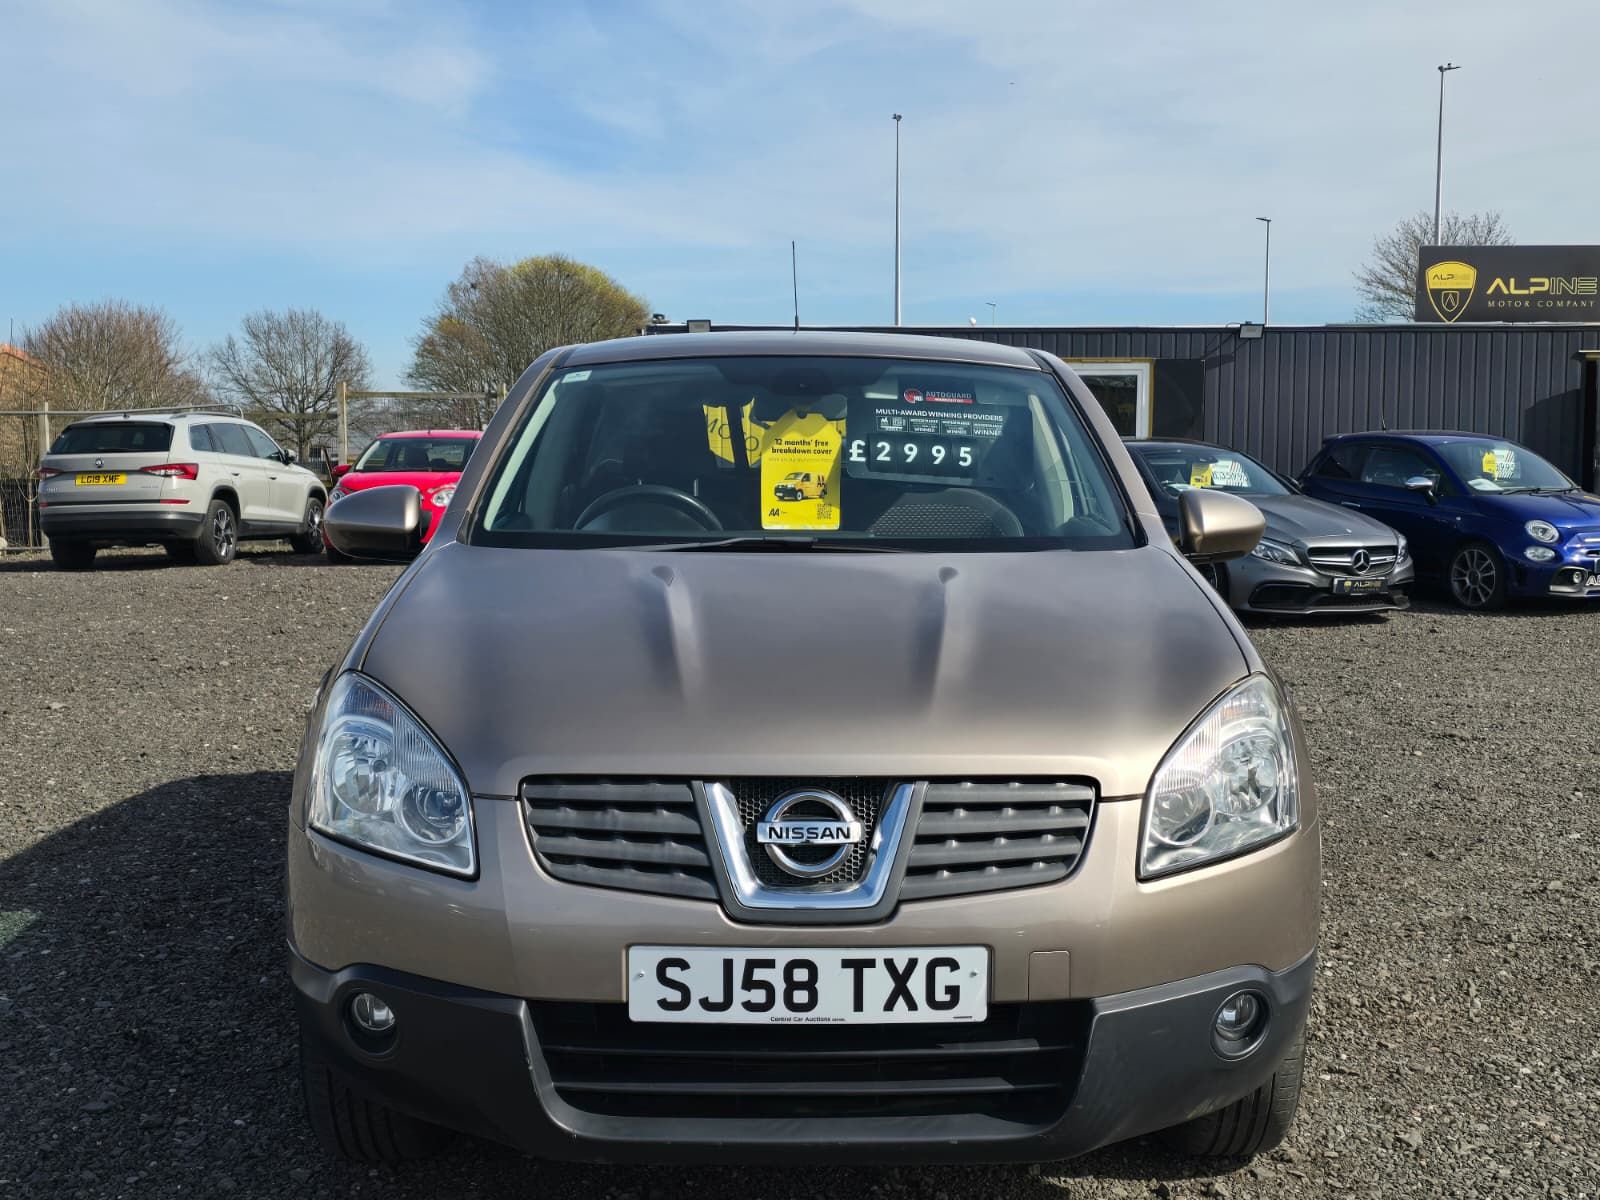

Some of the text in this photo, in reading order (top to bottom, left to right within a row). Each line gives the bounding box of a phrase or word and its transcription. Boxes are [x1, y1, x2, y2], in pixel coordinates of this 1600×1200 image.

[1486, 277, 1598, 295] ALPINE
[1487, 300, 1595, 308] MOTOR COMPANY
[925, 390, 972, 399] AUTOGUARD
[875, 408, 1004, 421] MULTI-AWARD WINNING PROVIDERS
[771, 446, 812, 454] breakdown
[848, 440, 972, 467] £2995
[768, 508, 780, 517] AA
[768, 827, 850, 840] NISSAN
[655, 956, 961, 1013] SJ58 TXG
